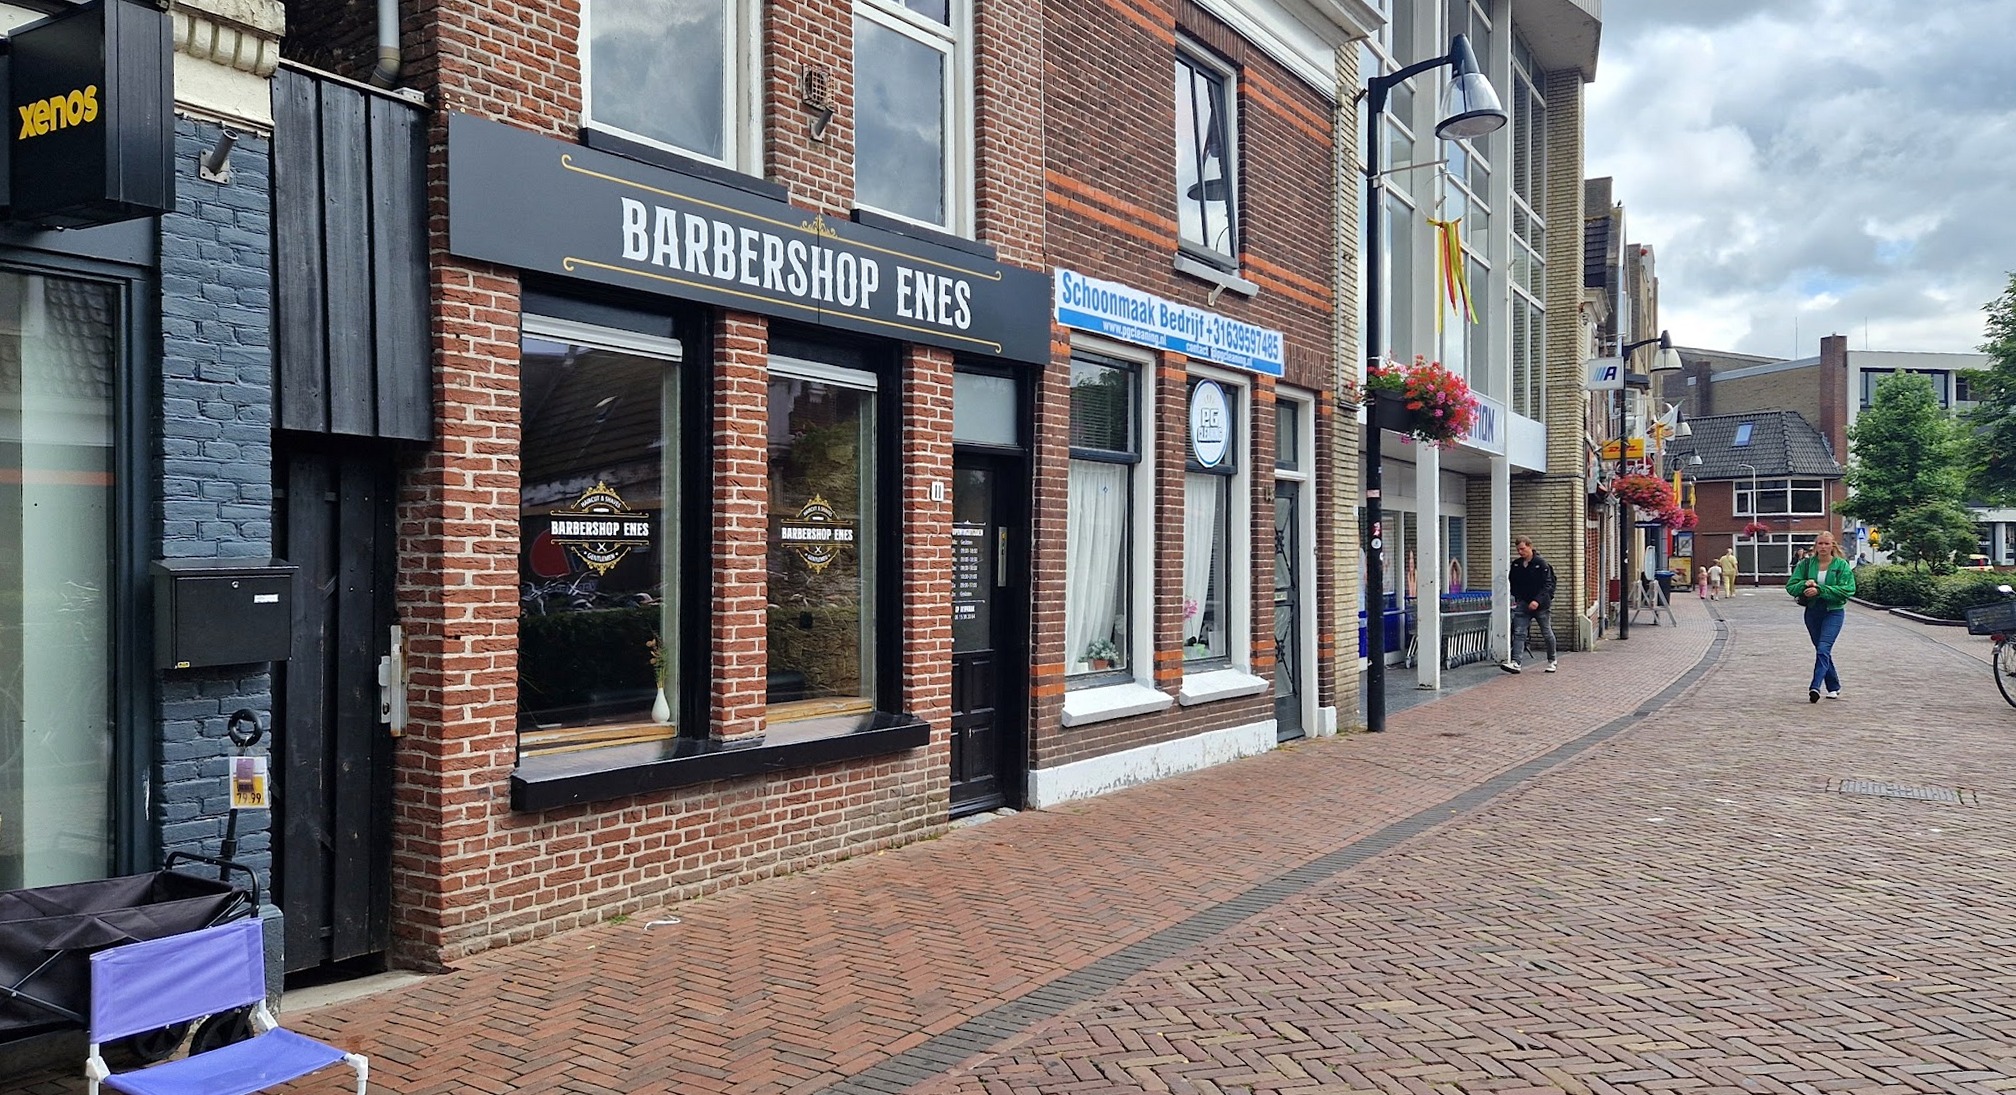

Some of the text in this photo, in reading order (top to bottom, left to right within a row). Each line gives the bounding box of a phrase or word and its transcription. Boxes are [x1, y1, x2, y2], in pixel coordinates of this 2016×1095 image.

[18, 84, 98, 140] xenos
[621, 196, 972, 331] BARBERSHOP ENES
[1062, 271, 1279, 360] Schoonmaak Bedrijf +31639597485
[1102, 320, 1167, 347] www.pgcleaning.nl
[1185, 341, 1210, 357] contact
[580, 495, 600, 508] HAIRCUT
[550, 520, 650, 537] BARBERSHOP ENES
[781, 527, 853, 541] BARBERSHOP ENES
[586, 552, 616, 563] GENTLEMEN
[236, 792, 262, 804] 79.99
